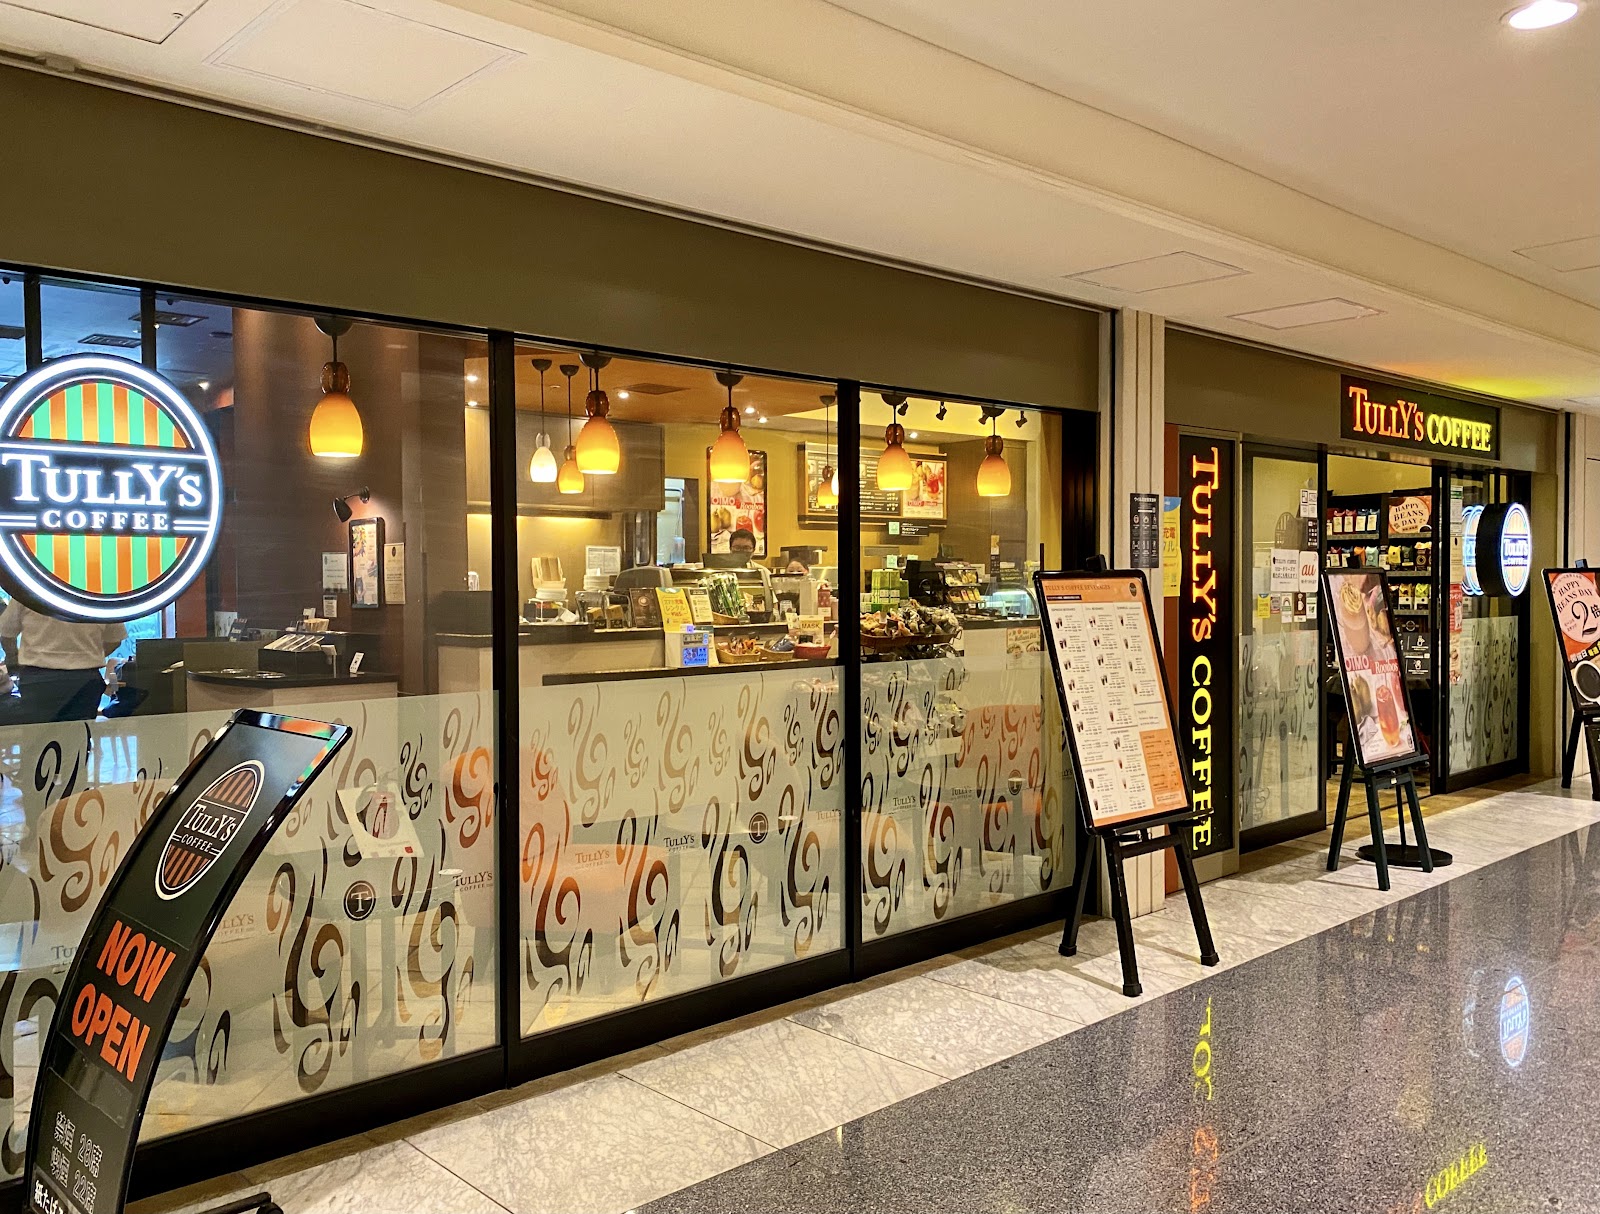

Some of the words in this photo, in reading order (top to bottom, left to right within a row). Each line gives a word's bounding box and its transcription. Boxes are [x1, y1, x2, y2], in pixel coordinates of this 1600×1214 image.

[1349, 386, 1424, 442] TULLY'S
[1427, 413, 1491, 452] COFFEE
[1, 453, 203, 507] TULLY'S
[1393, 510, 1424, 522] BEANS
[1395, 503, 1419, 513] HAPPY
[41, 510, 169, 530] COFFEE
[1401, 518, 1418, 527] DAY
[1191, 446, 1219, 643] TULLY'S
[1301, 564, 1316, 577] au
[1558, 580, 1580, 597] HAPPY
[1556, 592, 1578, 614] BEANS
[1578, 588, 1594, 597] DAY
[1345, 655, 1370, 671] OIMO
[1374, 661, 1399, 674] Rooibos
[1191, 655, 1212, 850] COFFEE
[893, 795, 916, 807] TULLY'S
[184, 803, 237, 842] TULLY'S
[181, 834, 213, 853] COFFEE
[663, 834, 695, 848] TULLY'S
[575, 849, 610, 864] TULLY'S
[453, 871, 493, 887] TULLY'S
[219, 913, 254, 929] LLY'S
[96, 919, 177, 1004] NOW
[71, 983, 151, 1083] OPEN
